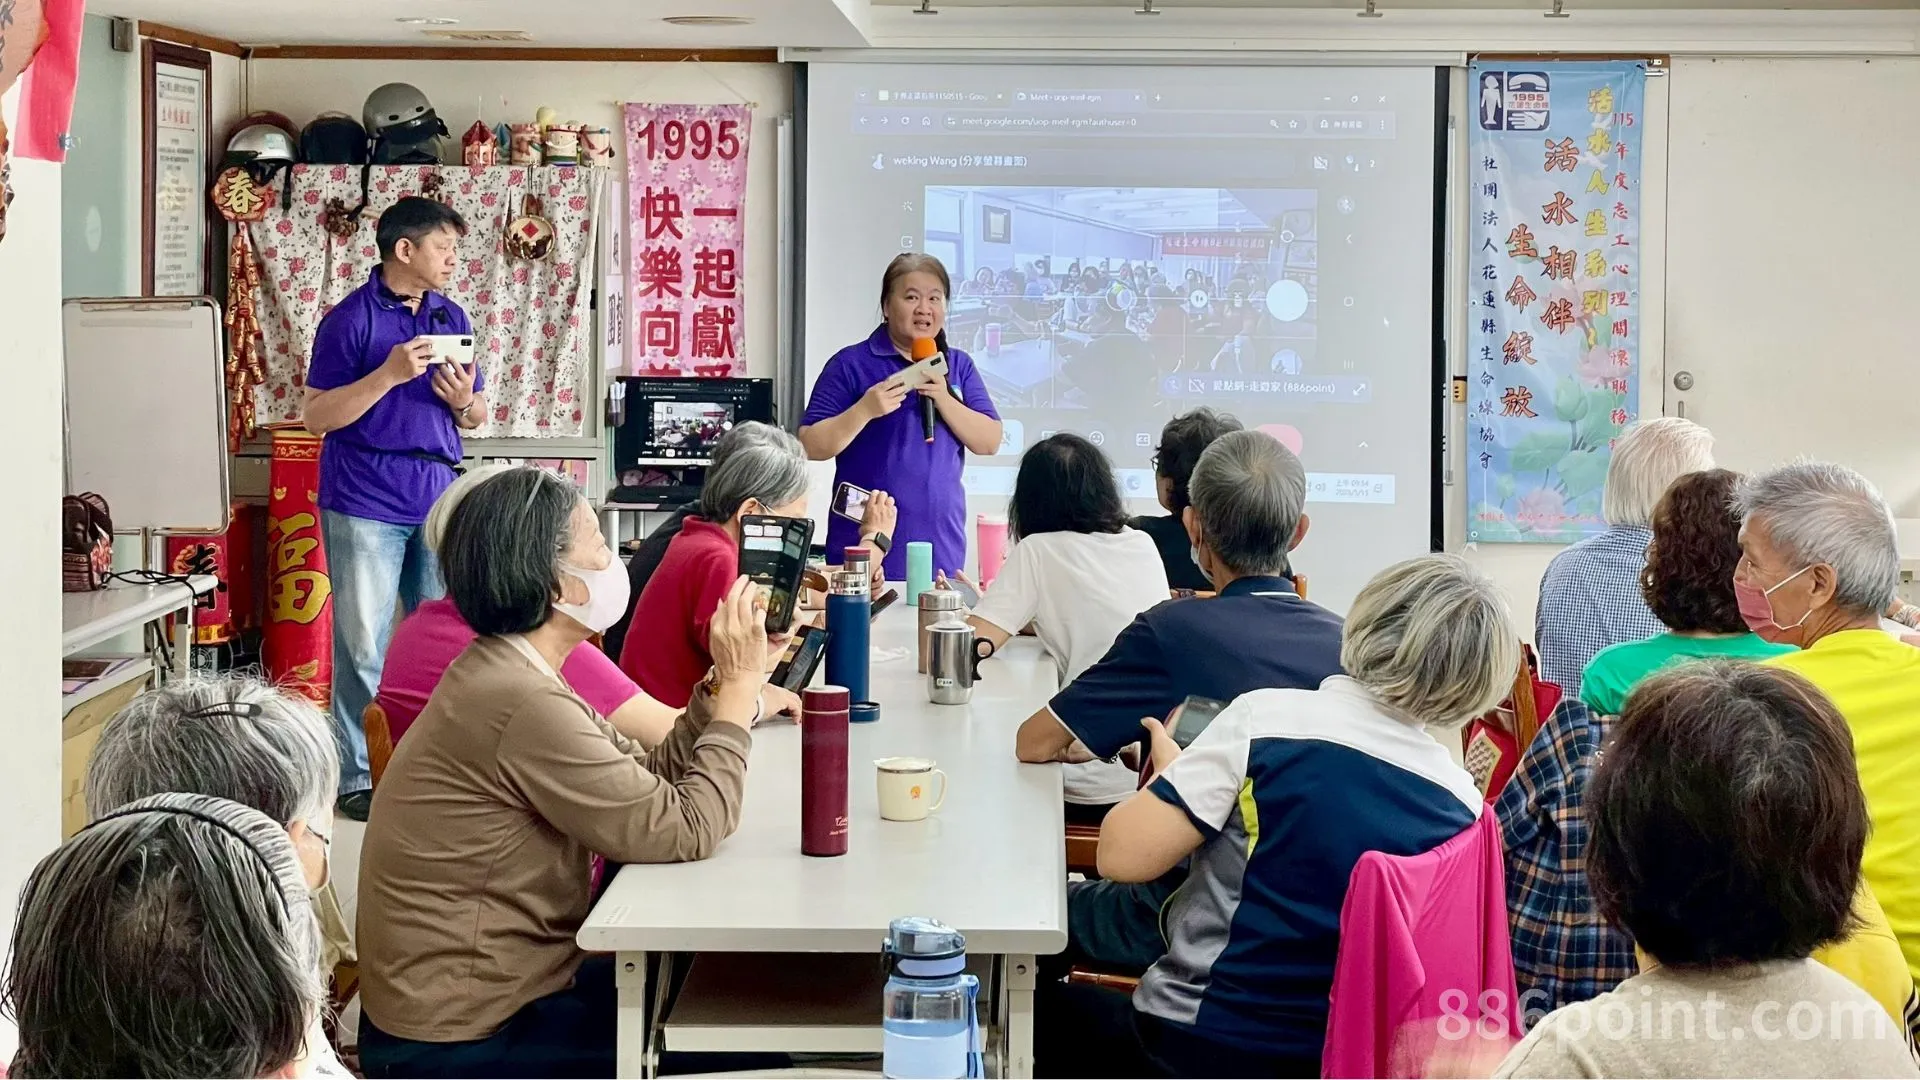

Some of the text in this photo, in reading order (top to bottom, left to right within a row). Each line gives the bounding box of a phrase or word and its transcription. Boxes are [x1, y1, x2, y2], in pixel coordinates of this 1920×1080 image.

[1512, 93, 1545, 101] 1995
[637, 119, 740, 161] 1995
[930, 155, 958, 168] Wang
[224, 169, 257, 215] 春
[1539, 136, 1581, 335] 活水相伴
[638, 185, 684, 377] 快樂向
[1499, 222, 1540, 419] 生命綻放
[1283, 381, 1336, 395] (886point)
